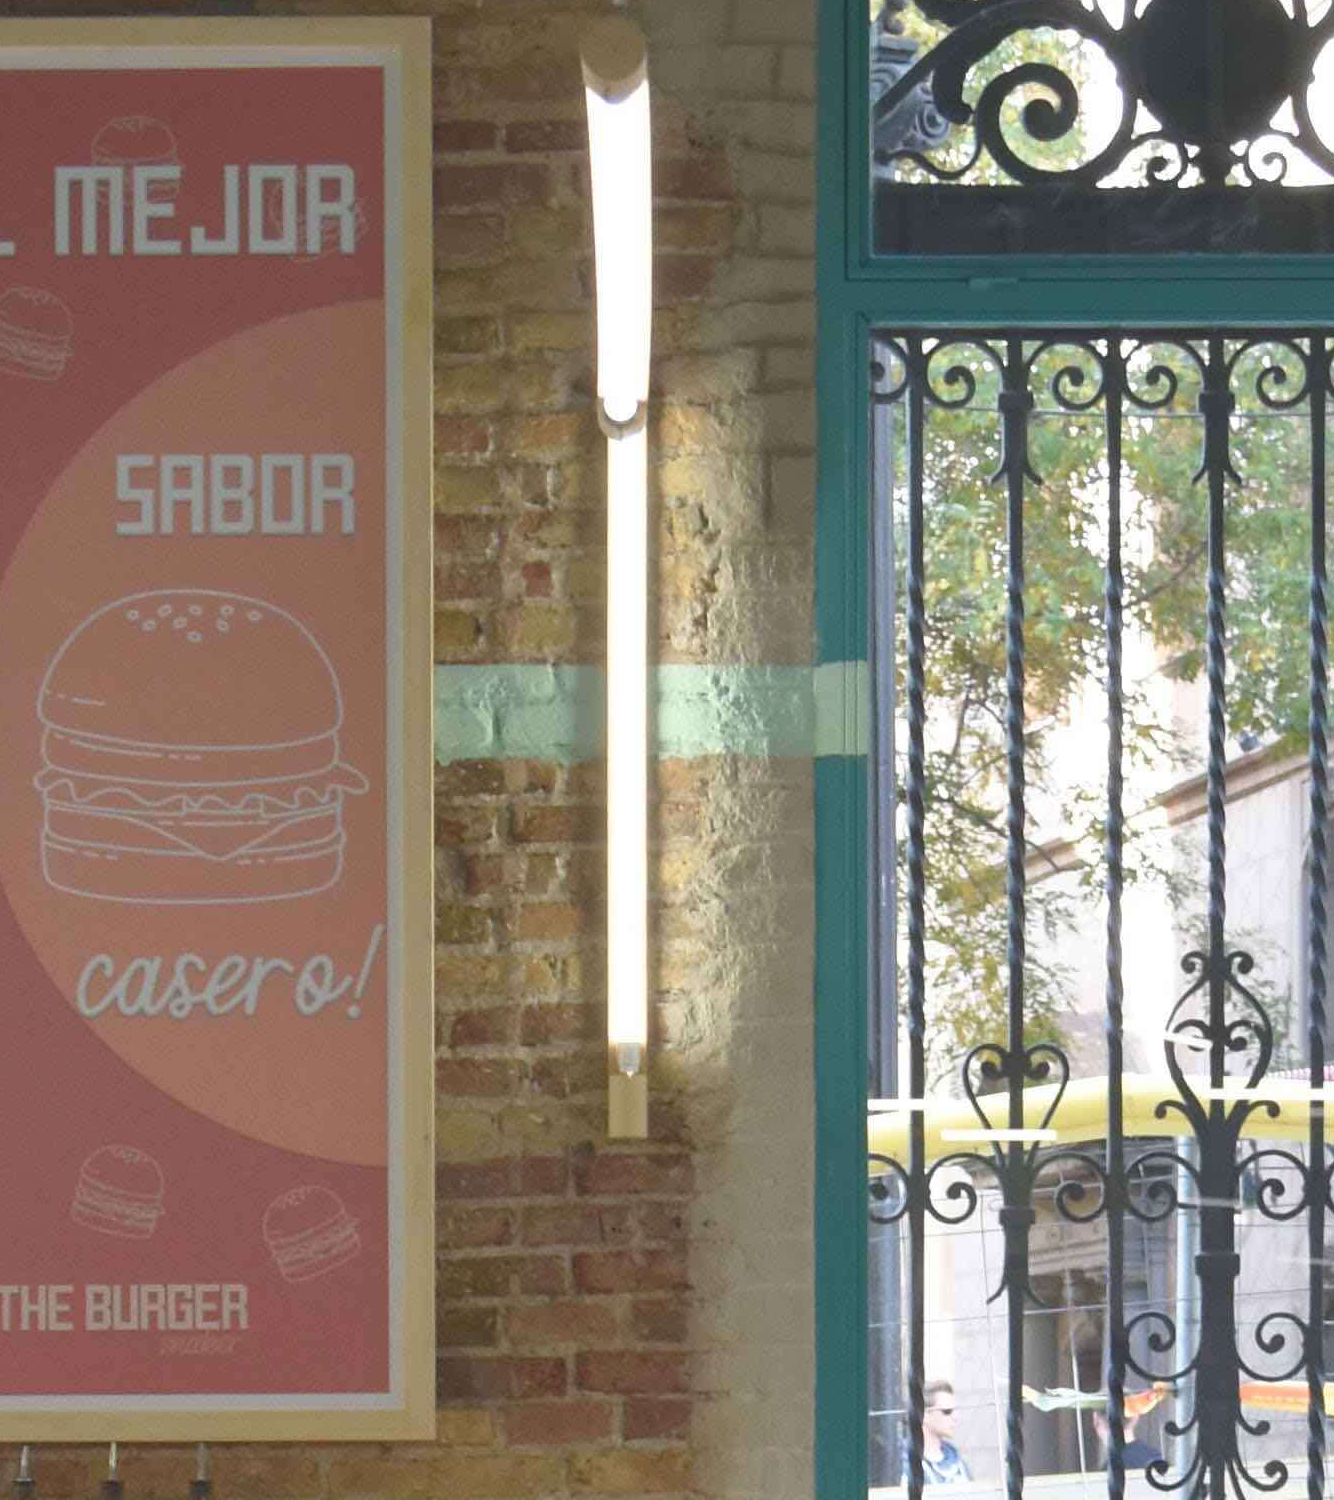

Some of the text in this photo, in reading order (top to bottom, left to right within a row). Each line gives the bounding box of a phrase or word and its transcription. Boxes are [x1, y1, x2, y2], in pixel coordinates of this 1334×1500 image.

[54, 164, 355, 256] MEJOR
[115, 454, 355, 535] SABOR
[77, 924, 385, 1018] casero!
[85, 1284, 249, 1332] BURGER
